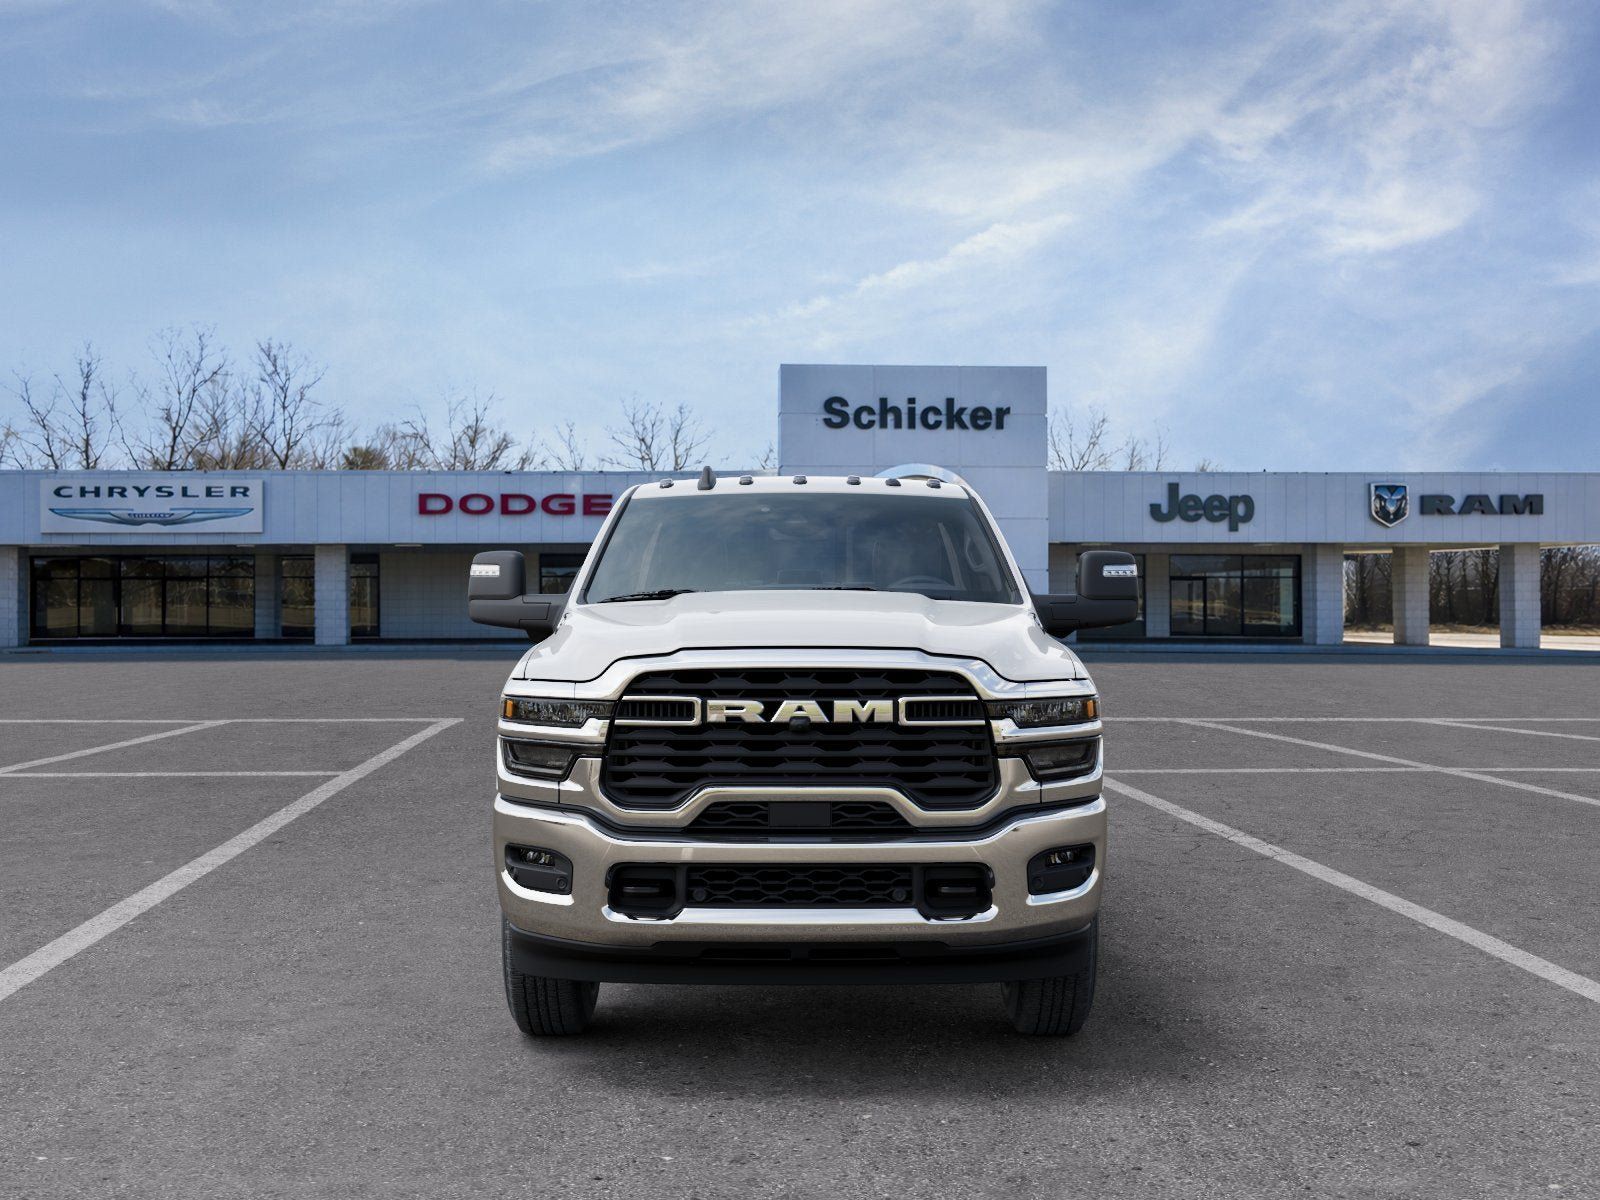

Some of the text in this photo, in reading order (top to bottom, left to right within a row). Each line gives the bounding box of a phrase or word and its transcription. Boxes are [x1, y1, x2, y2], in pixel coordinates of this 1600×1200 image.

[822, 396, 1011, 430] Schicker
[53, 485, 250, 498] CHRYSLER
[418, 493, 613, 516] DODGE
[1149, 482, 1255, 532] Jeep
[1420, 494, 1544, 515] RAM
[706, 700, 894, 723] RAM
